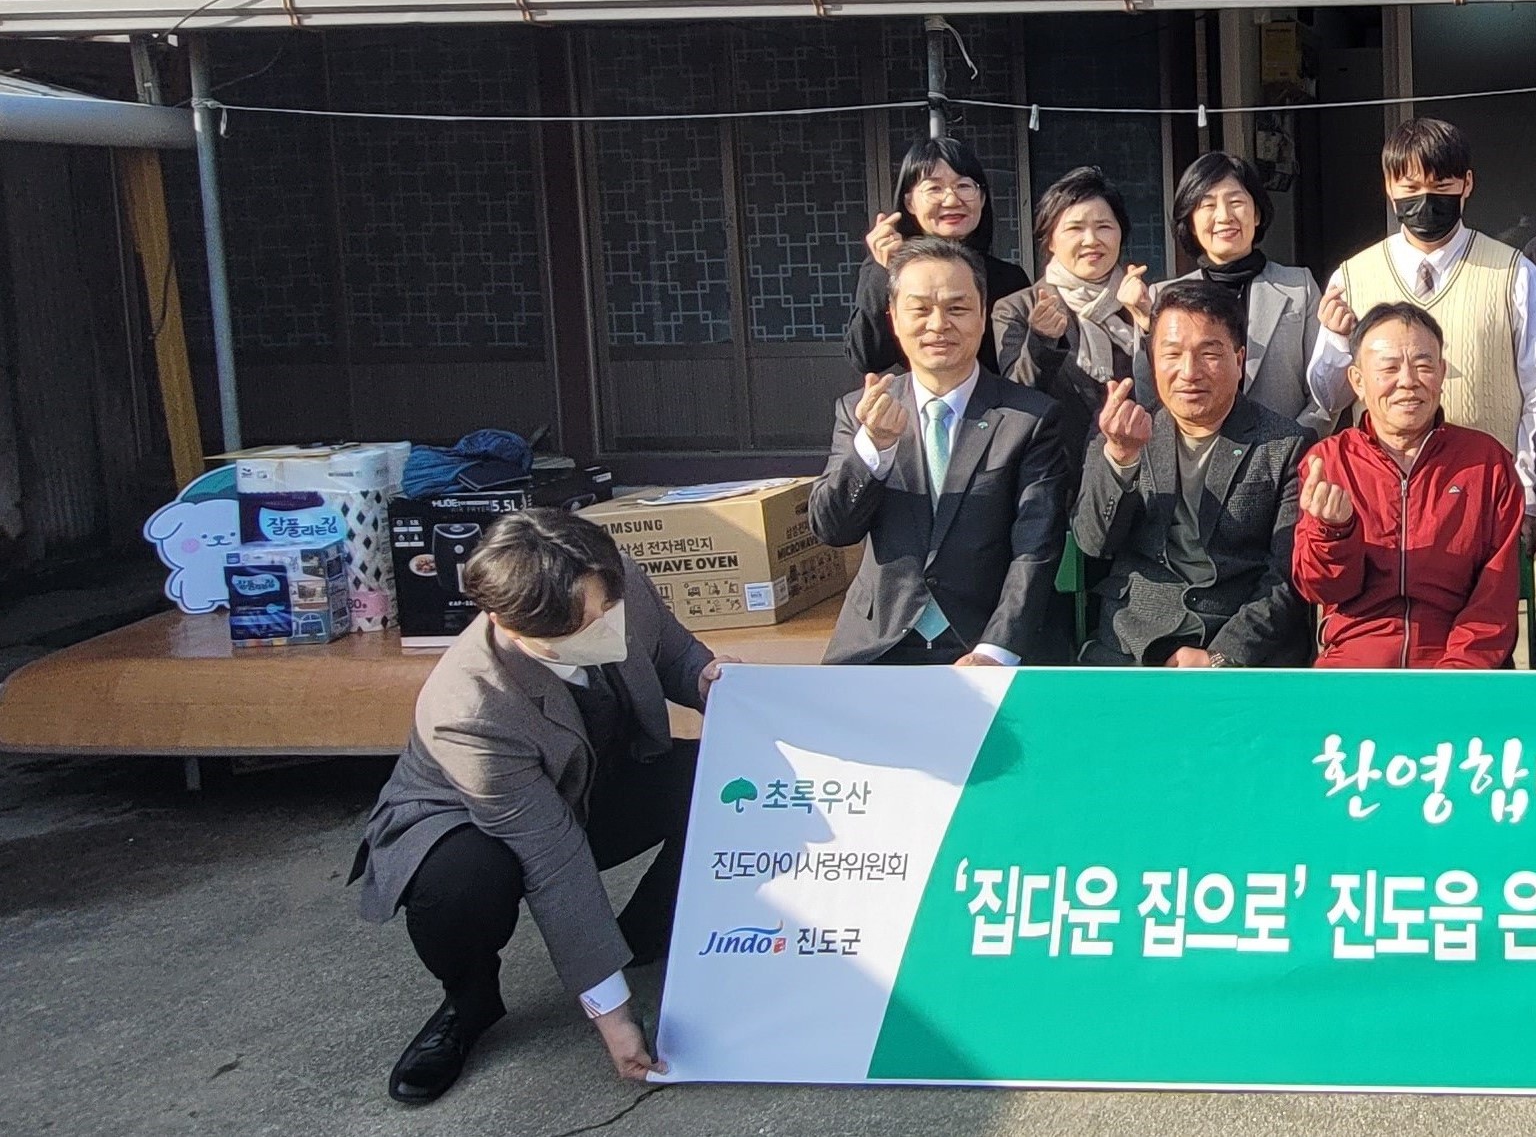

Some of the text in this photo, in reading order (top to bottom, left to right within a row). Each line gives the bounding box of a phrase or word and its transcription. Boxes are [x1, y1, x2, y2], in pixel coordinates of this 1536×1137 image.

[491, 499, 519, 513] 5.5L
[601, 519, 663, 535] AMSUNG
[647, 536, 714, 555] 전자레인지
[696, 554, 739, 570] OVEN
[762, 779, 872, 815] 초록우산
[711, 851, 909, 881] 진도아이사랑위원회
[1326, 870, 1483, 961] 진도읍
[698, 930, 772, 956] Jindo
[796, 926, 861, 956] 진도군
